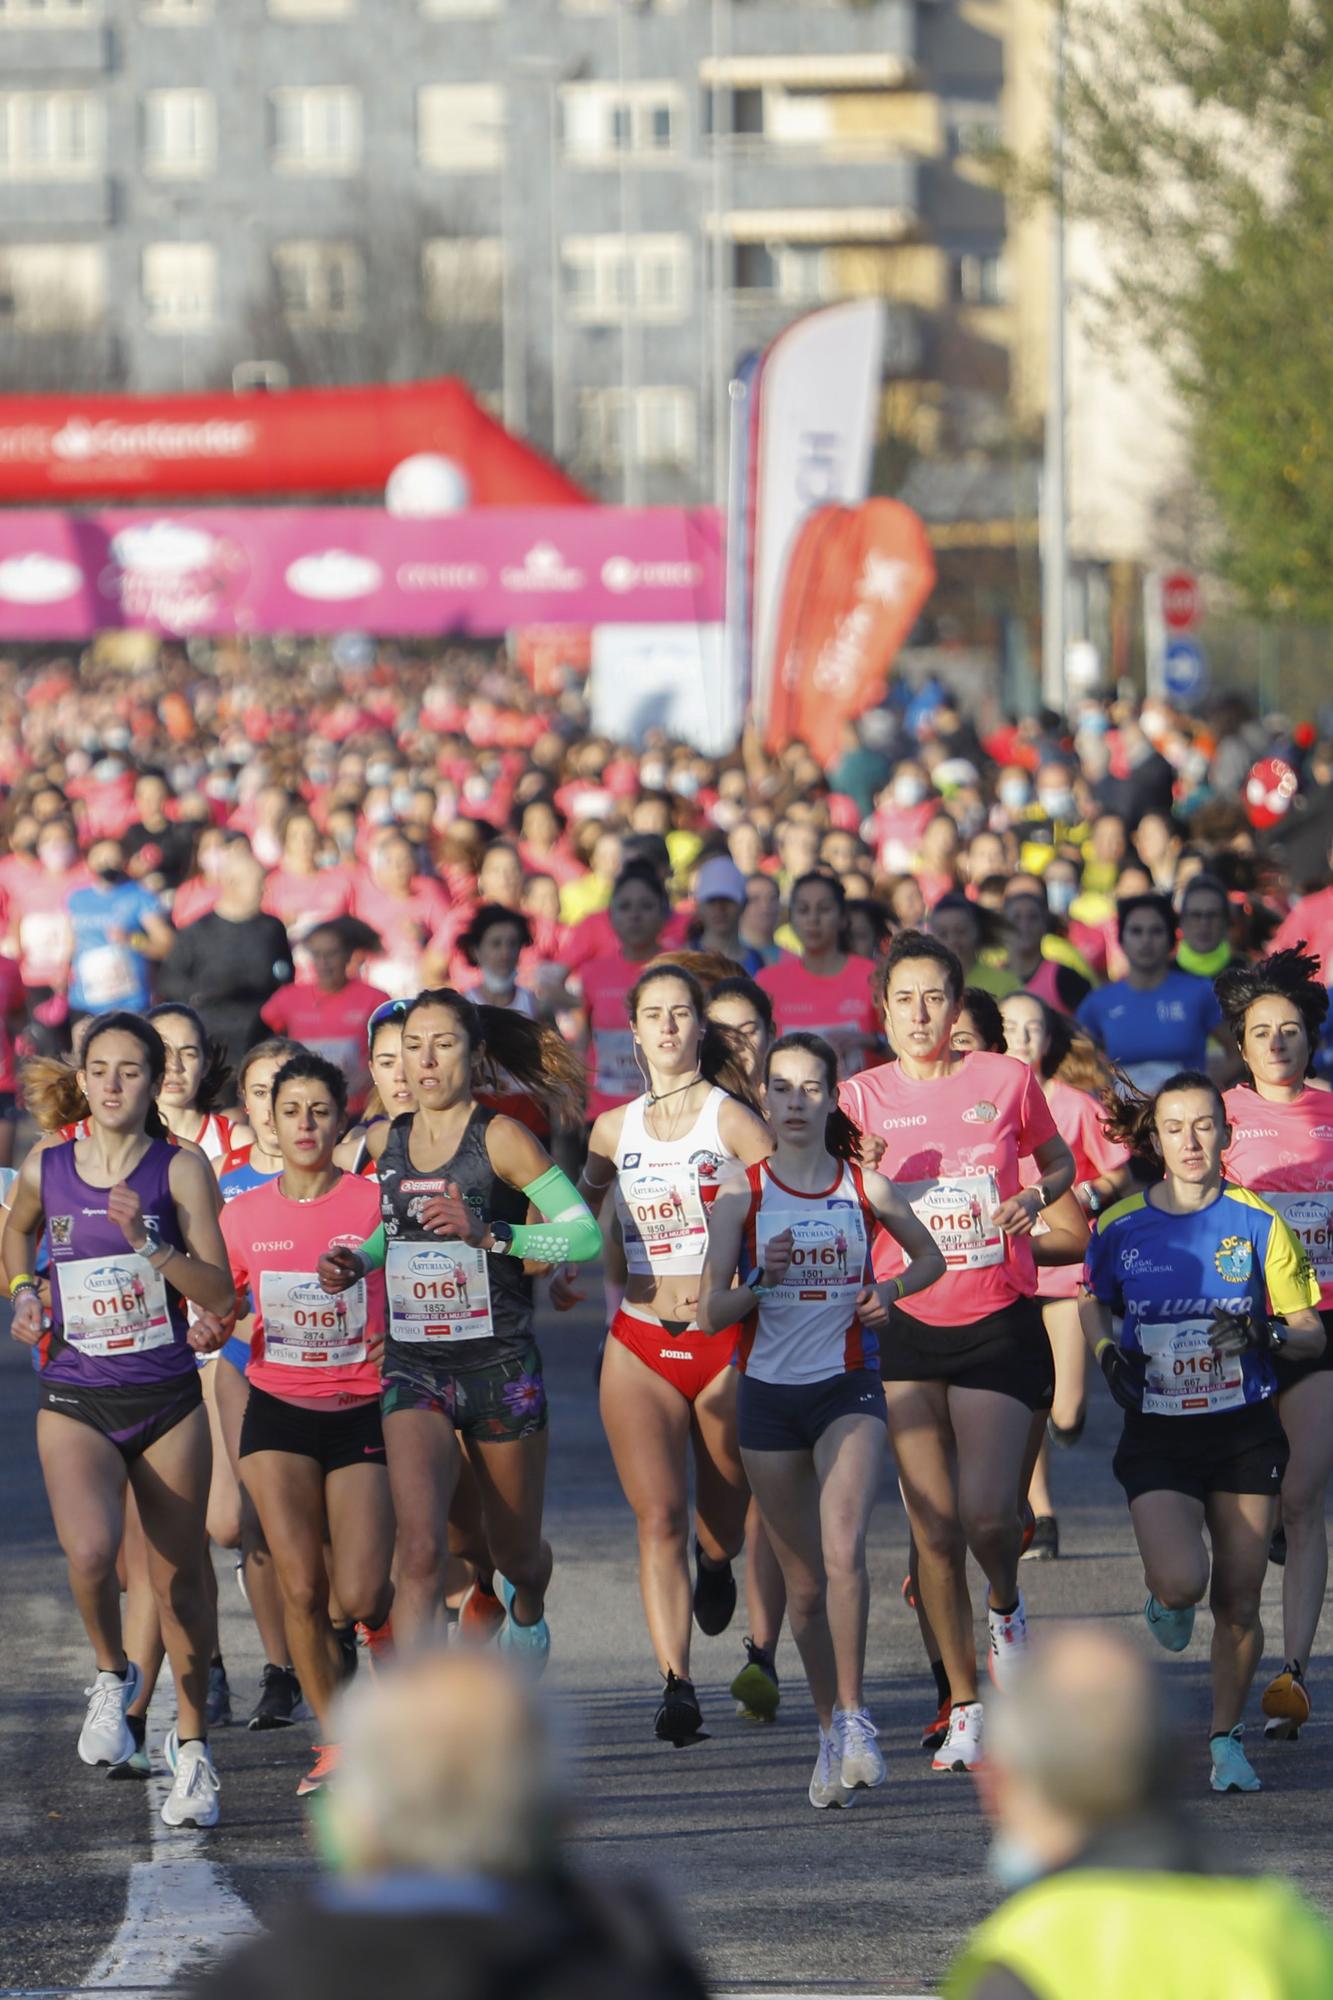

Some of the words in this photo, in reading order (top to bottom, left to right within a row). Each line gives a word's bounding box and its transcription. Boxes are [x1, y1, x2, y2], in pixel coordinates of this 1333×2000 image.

[883, 1115, 927, 1130] OYSHO
[1236, 1128, 1278, 1140] OYSHO
[928, 1193, 968, 1203] ASTURIANA
[637, 1202, 673, 1221] 016
[930, 1214, 972, 1231] 016
[793, 1229, 834, 1238] ASTURIANA
[252, 1240, 294, 1253] OYSHO
[1221, 1235, 1239, 1250] DC
[791, 1248, 835, 1266] 016
[412, 1262, 452, 1271] ASTURIANA
[802, 1269, 823, 1278] 1501
[413, 1282, 455, 1299] 016
[92, 1293, 135, 1316] 016
[424, 1303, 446, 1312] 1852
[1128, 1300, 1151, 1316] DC
[114, 1318, 120, 1327] 2
[294, 1310, 335, 1327] 016
[304, 1331, 324, 1340] 2874
[1173, 1357, 1212, 1376] 016
[1184, 1378, 1201, 1387] 667
